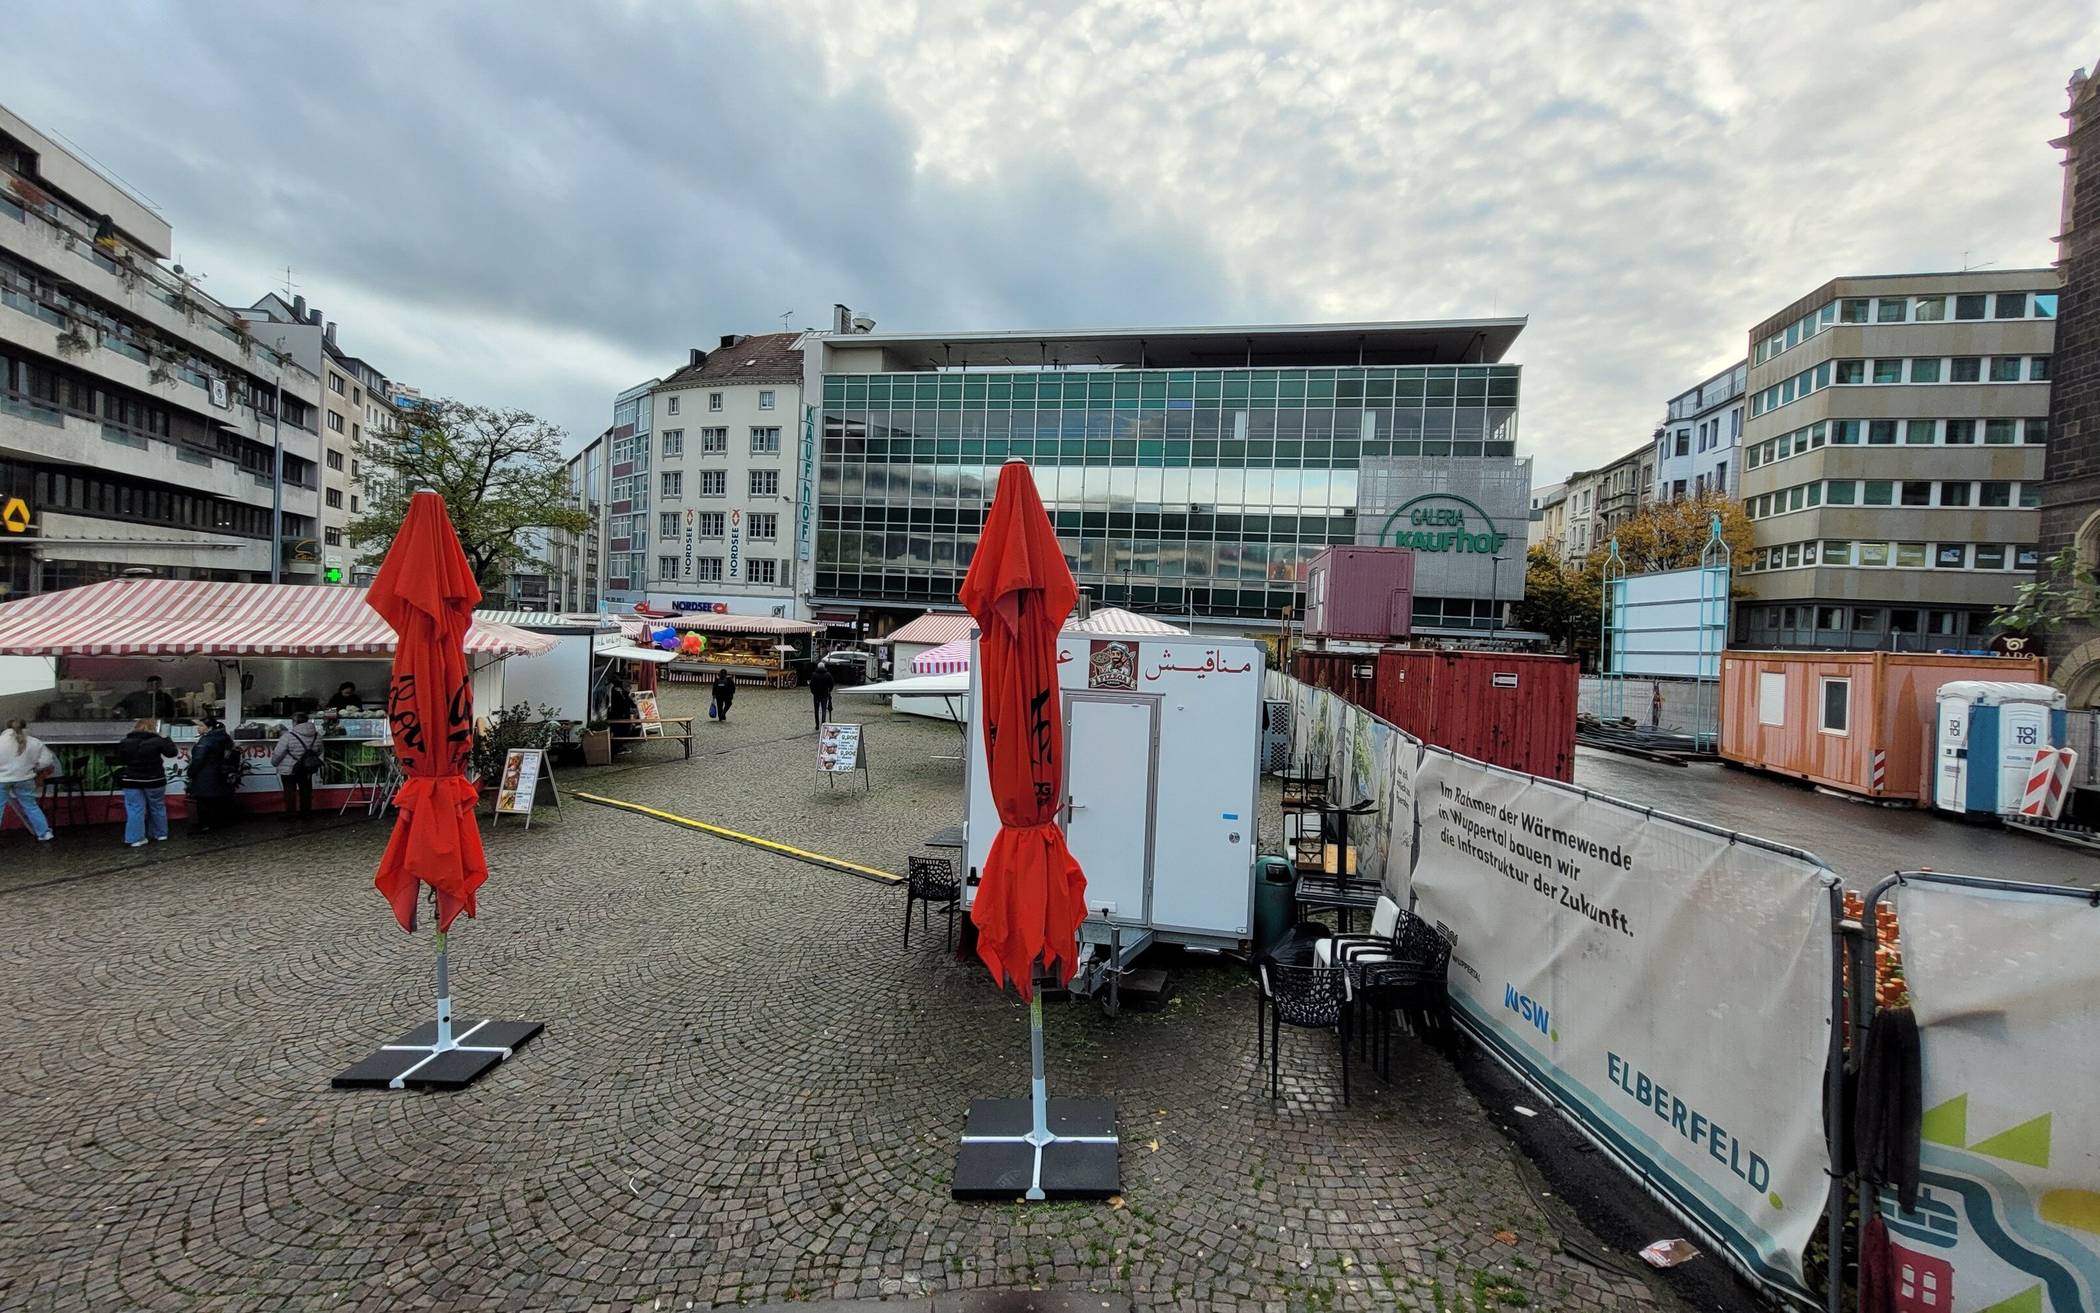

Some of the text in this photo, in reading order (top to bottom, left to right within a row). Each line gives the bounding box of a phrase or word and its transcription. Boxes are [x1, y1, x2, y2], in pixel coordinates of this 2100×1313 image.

[1411, 508, 1465, 526] GALERIA
[685, 527, 693, 575] NORDSEE
[730, 527, 739, 577] NORDSEE
[672, 601, 712, 612] NORDSEE
[1145, 649, 1251, 680] مناقيش
[2016, 726, 2037, 735] TOI
[2016, 735, 2037, 744] TOI
[1438, 804, 1580, 881] in Wuppertal bauen wir
[1440, 781, 1453, 799] Im
[1454, 787, 1497, 817] Rahmen
[1499, 803, 1518, 826] der
[1521, 812, 1632, 871] Wärmewende
[1440, 827, 1455, 847] die
[1458, 835, 1529, 885] Infrastruktur
[1534, 873, 1558, 899] der
[1560, 886, 1634, 937] Zukunft.
